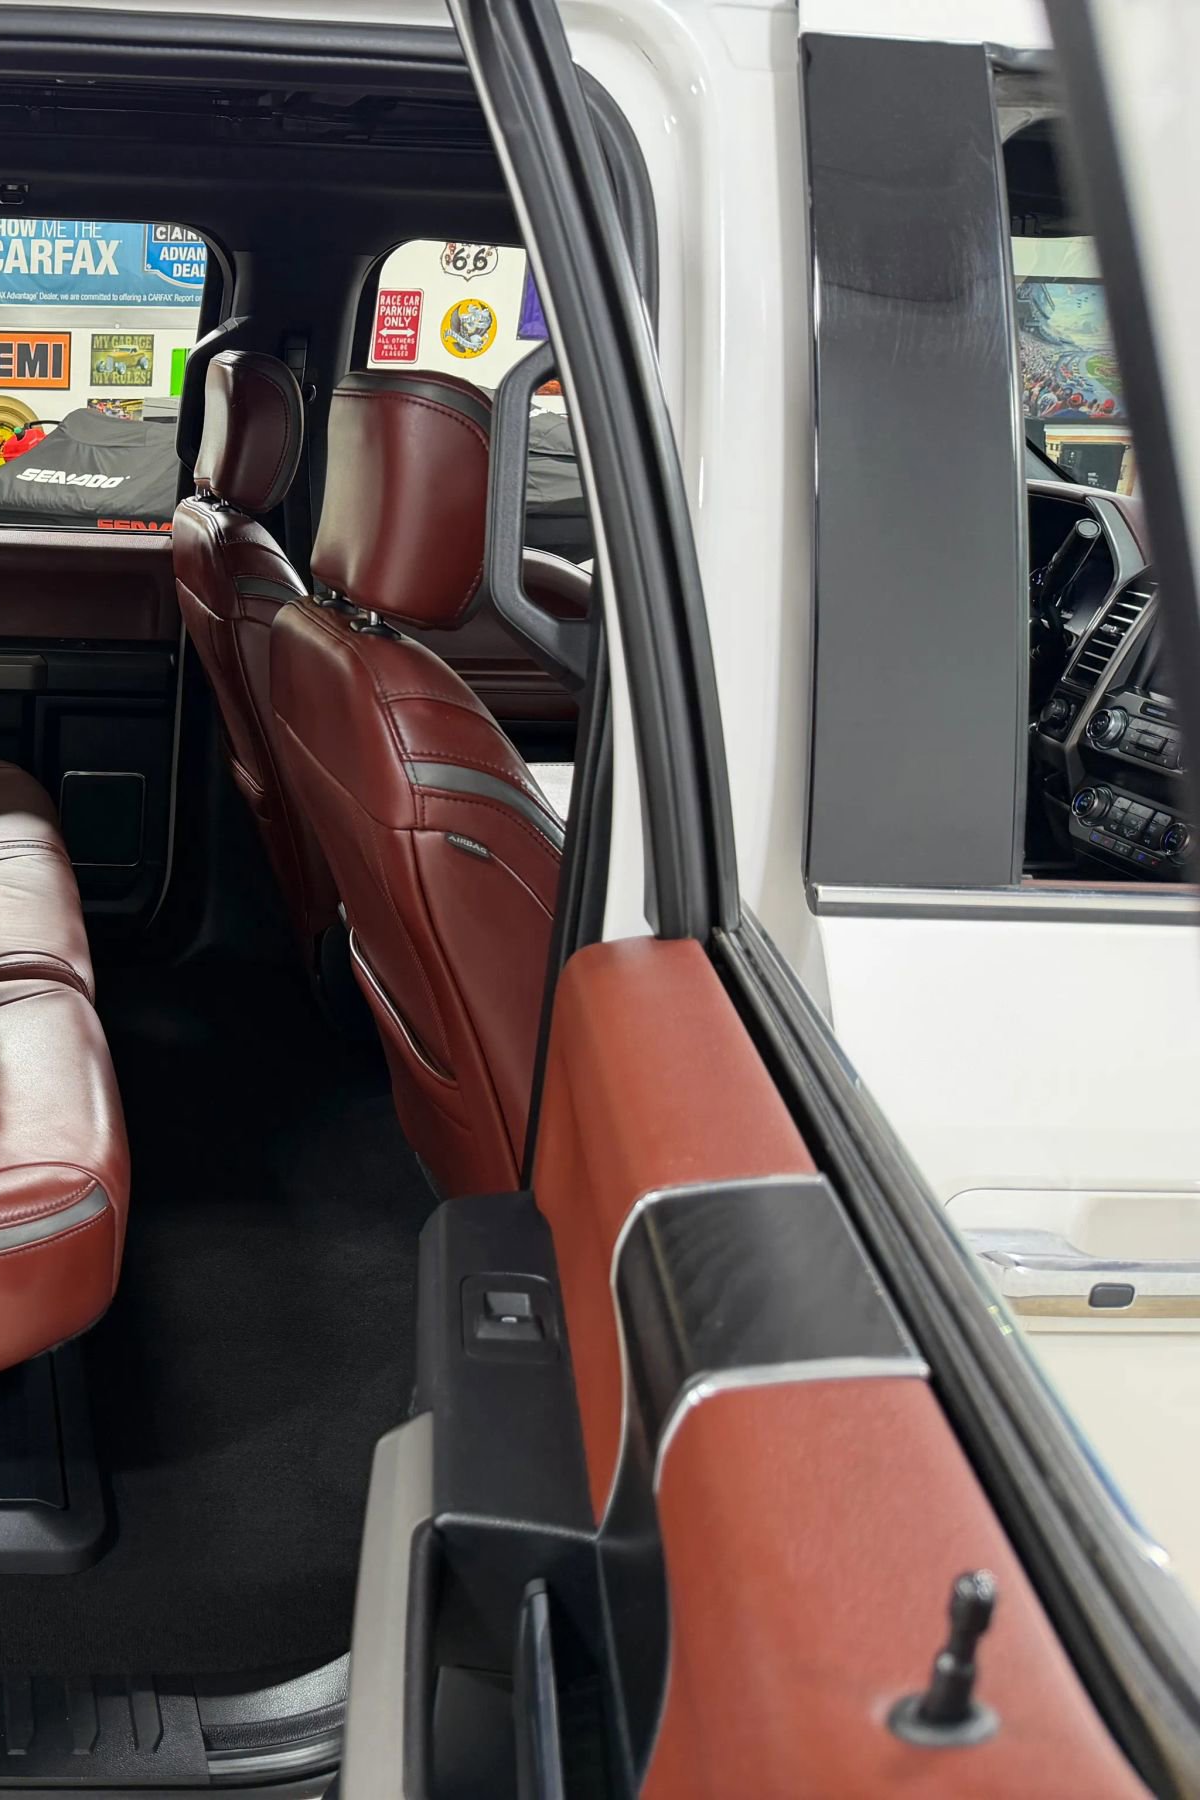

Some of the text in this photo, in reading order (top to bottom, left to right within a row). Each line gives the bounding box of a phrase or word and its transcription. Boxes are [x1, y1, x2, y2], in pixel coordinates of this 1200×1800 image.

[41, 220, 67, 238] ME
[73, 221, 103, 239] THE
[452, 247, 488, 271] 66
[80, 293, 112, 301] committed
[119, 293, 142, 303] offering
[174, 294, 194, 303] Report
[380, 295, 420, 306] RACE CAR
[379, 305, 418, 317] PARKING
[384, 316, 412, 328] ONLY
[93, 335, 152, 349] MY GARAGE
[391, 337, 416, 345] OTHERS
[92, 371, 151, 385] MY RULES!
